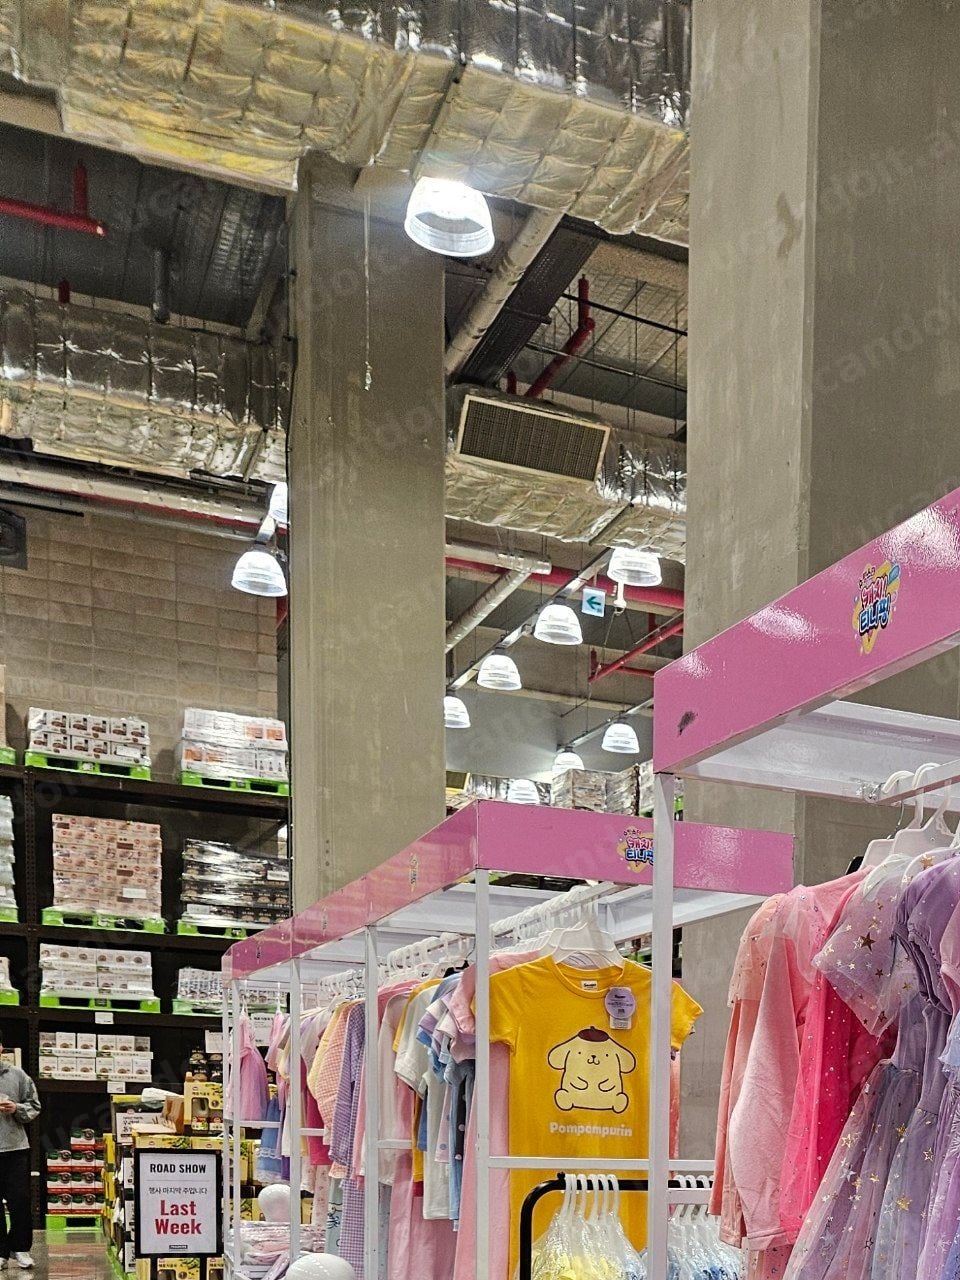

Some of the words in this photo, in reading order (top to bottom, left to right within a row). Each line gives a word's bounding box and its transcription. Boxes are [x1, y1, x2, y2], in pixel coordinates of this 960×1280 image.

[859, 594, 890, 635] 티니핑
[549, 1121, 634, 1138] Pompompurin
[150, 1163, 176, 1173] ROAD
[179, 1164, 207, 1173] SHOW
[149, 1187, 161, 1195] 행사
[163, 1187, 181, 1195] 마지막
[183, 1187, 208, 1195] 주입니다
[160, 1200, 197, 1216] Last
[155, 1219, 202, 1235] Week
